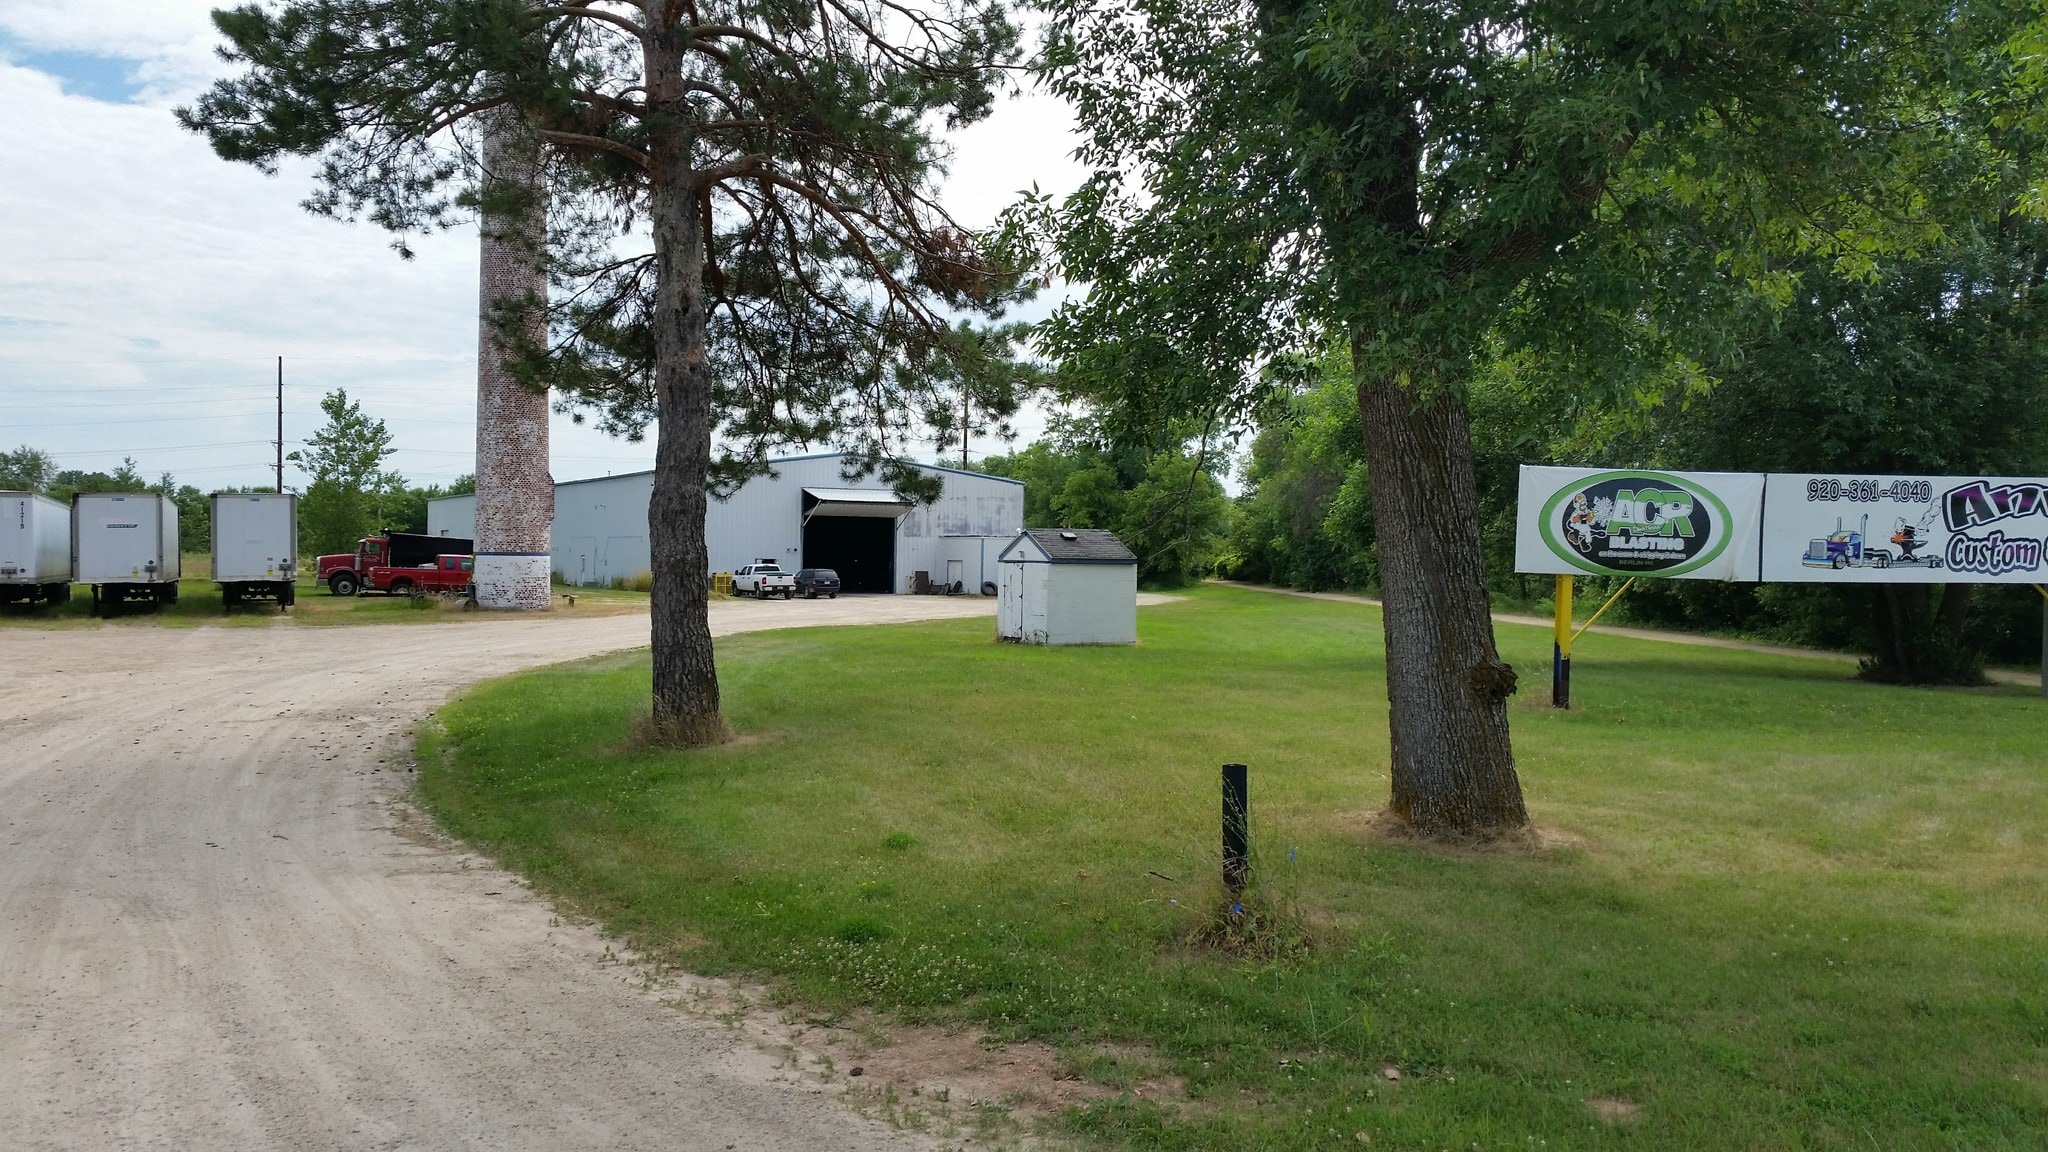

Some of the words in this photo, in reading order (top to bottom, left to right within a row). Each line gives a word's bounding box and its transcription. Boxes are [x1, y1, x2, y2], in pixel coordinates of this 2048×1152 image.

[1807, 479, 1932, 502] 920-361-4040
[1606, 488, 1695, 537] ACR
[1609, 536, 1685, 551] BLASTING
[1945, 530, 2041, 576] Custom
